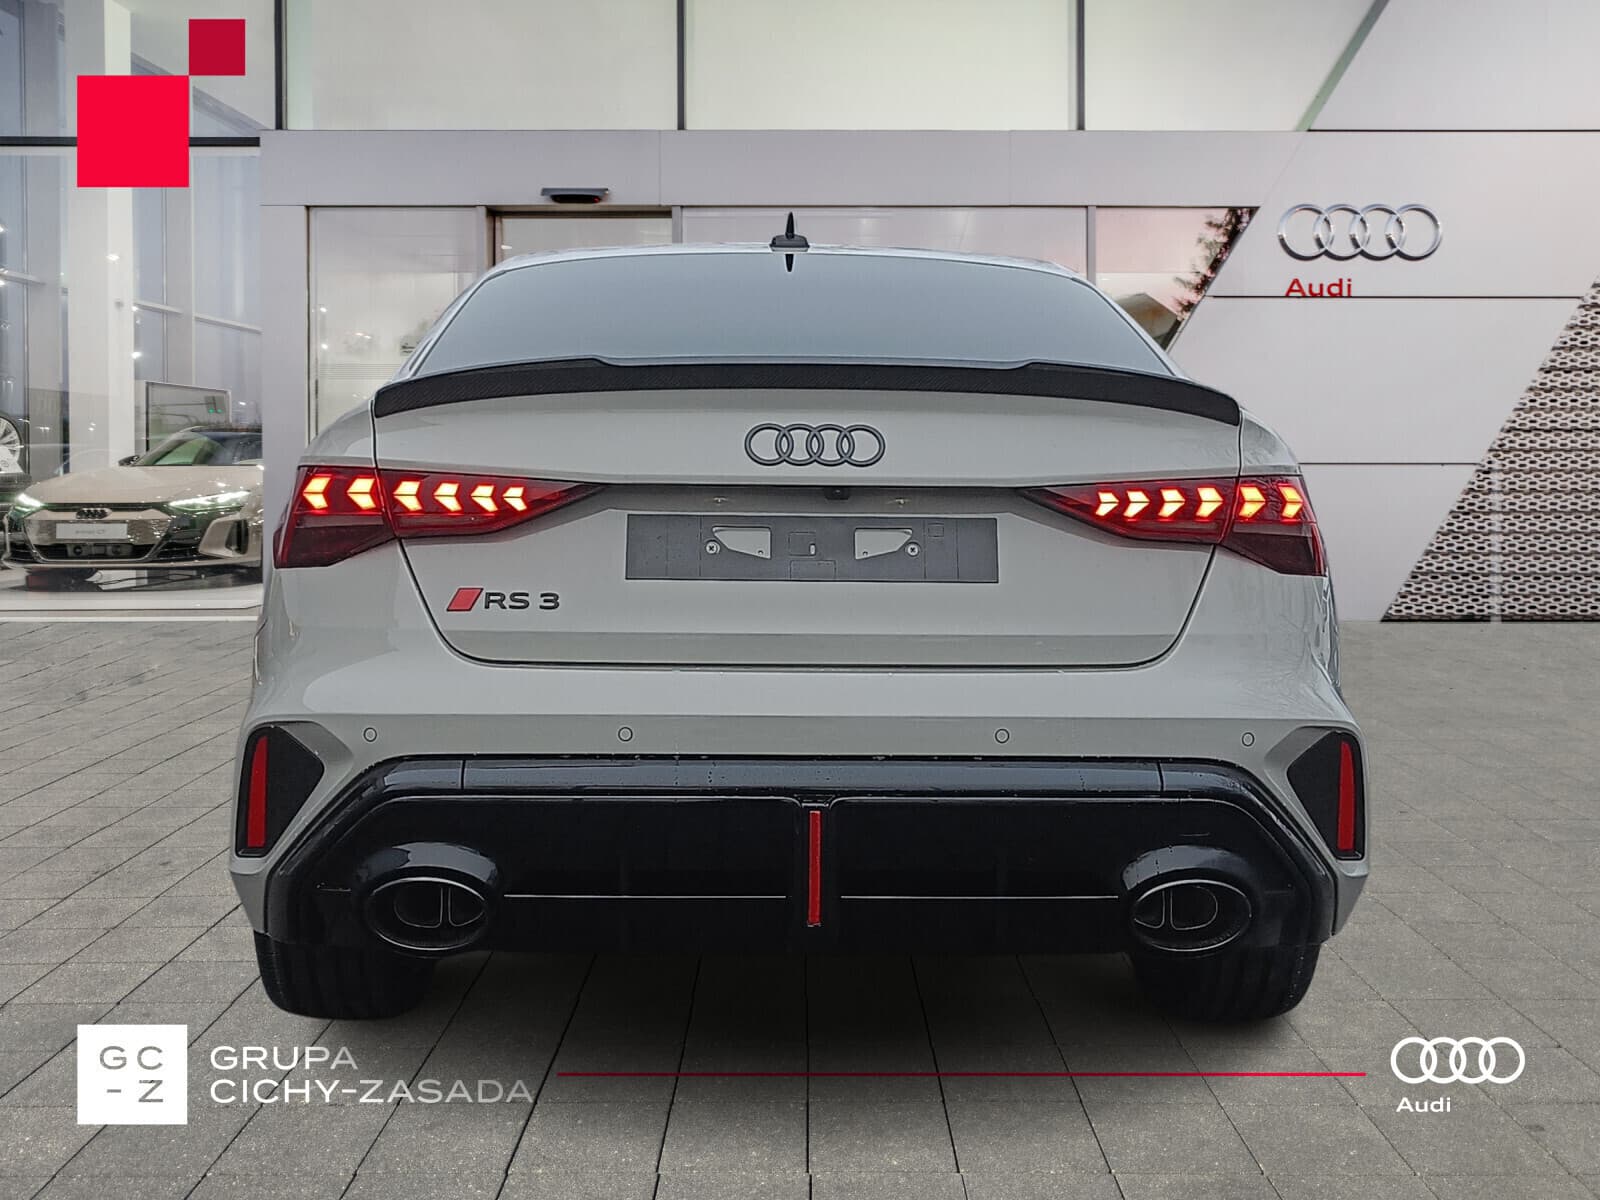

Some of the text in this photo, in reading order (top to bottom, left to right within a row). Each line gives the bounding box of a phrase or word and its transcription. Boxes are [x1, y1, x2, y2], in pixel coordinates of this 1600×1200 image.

[1285, 278, 1352, 297] Audi
[484, 592, 560, 610] RS 3
